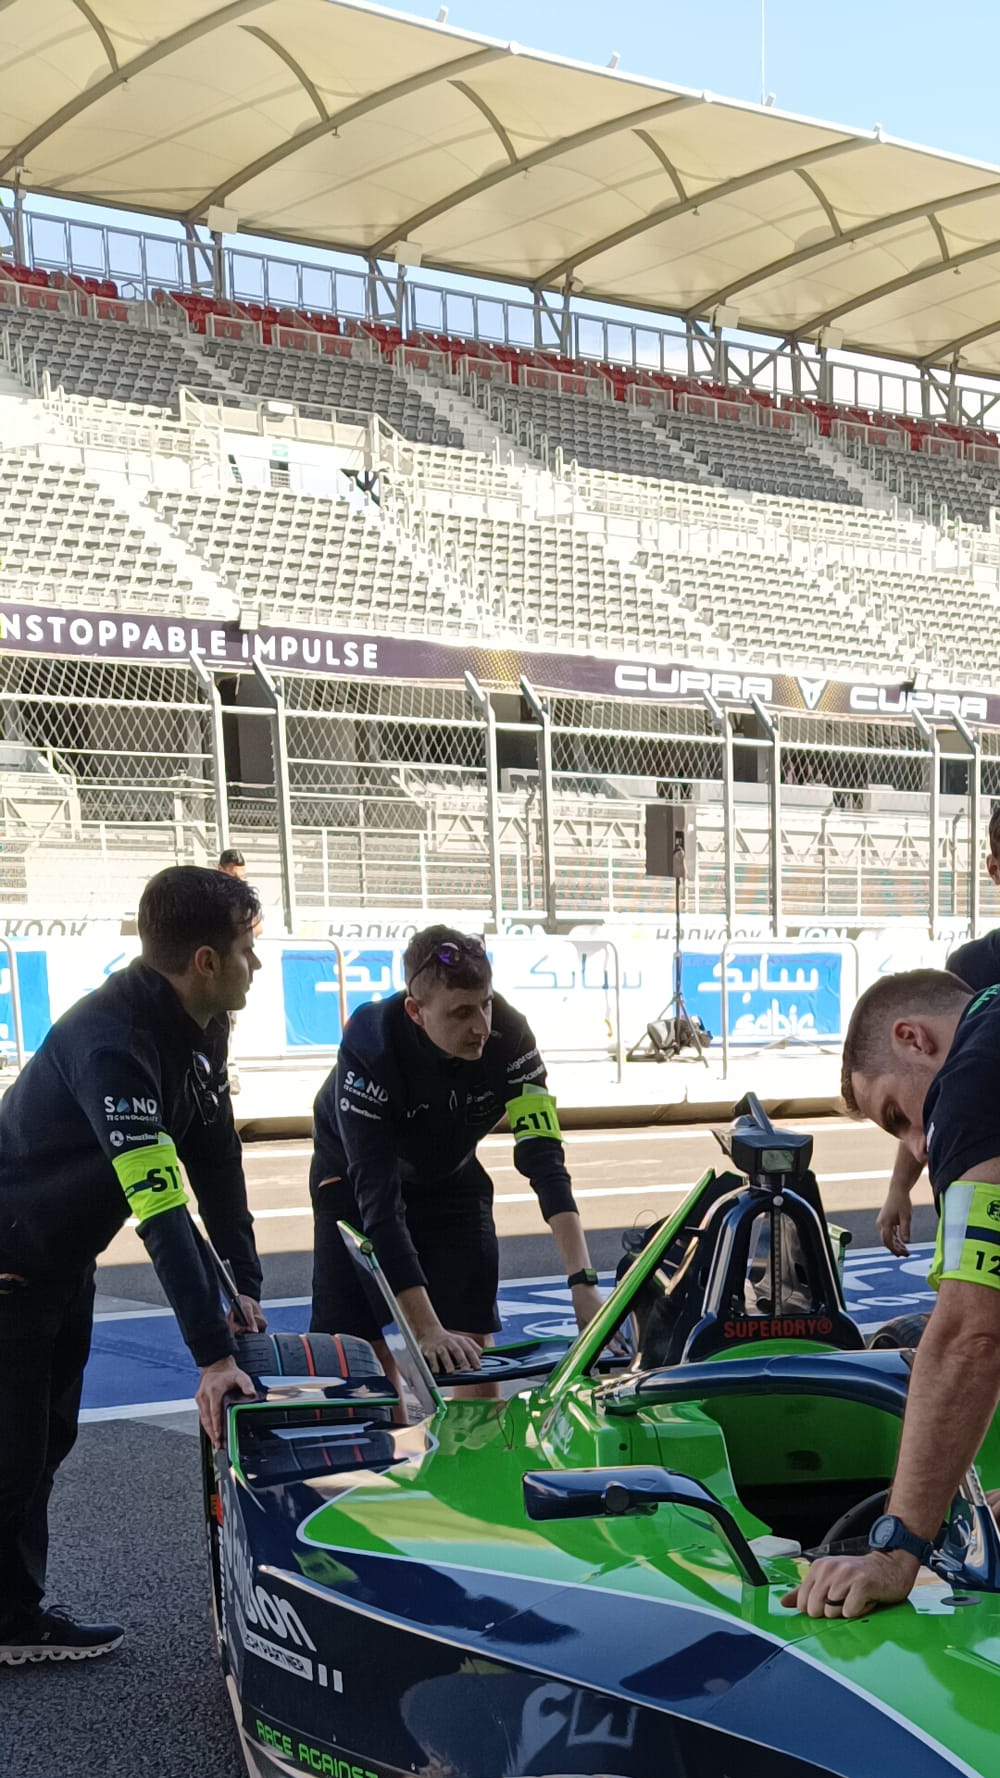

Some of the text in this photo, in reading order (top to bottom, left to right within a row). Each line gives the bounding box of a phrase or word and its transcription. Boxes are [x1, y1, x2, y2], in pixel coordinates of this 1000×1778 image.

[241, 632, 379, 669] IMPULSE
[614, 664, 773, 700] CUPRA
[849, 685, 988, 720] CUPRA
[146, 1165, 181, 1193] S1
[256, 1719, 295, 1757] RACE
